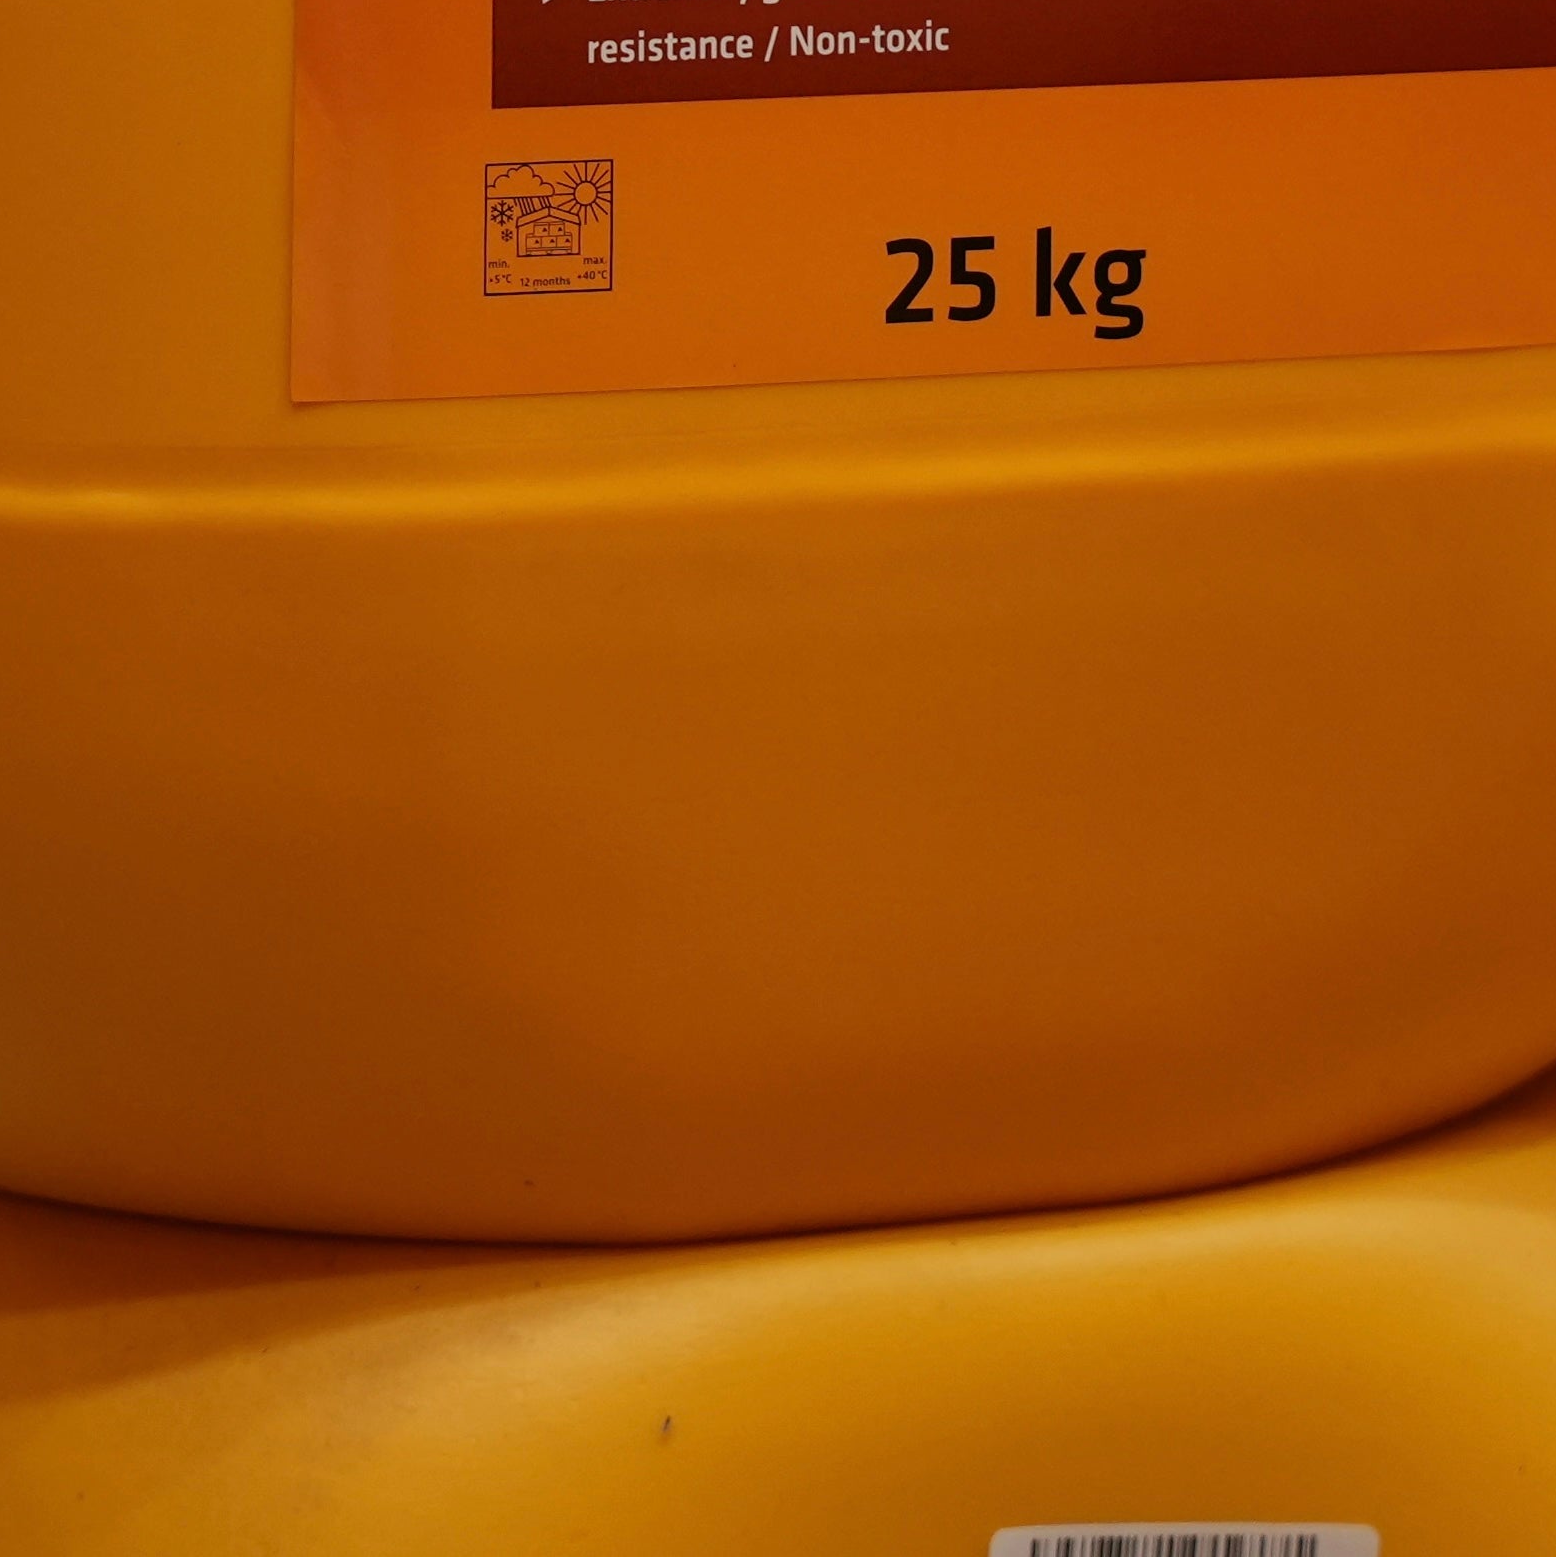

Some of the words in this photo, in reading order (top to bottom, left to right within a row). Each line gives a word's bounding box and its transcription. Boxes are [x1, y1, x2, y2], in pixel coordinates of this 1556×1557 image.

[588, 29, 754, 64] resistance
[790, 19, 950, 57] Non-toxic
[885, 235, 996, 324] 25
[1035, 225, 1147, 340] kg
